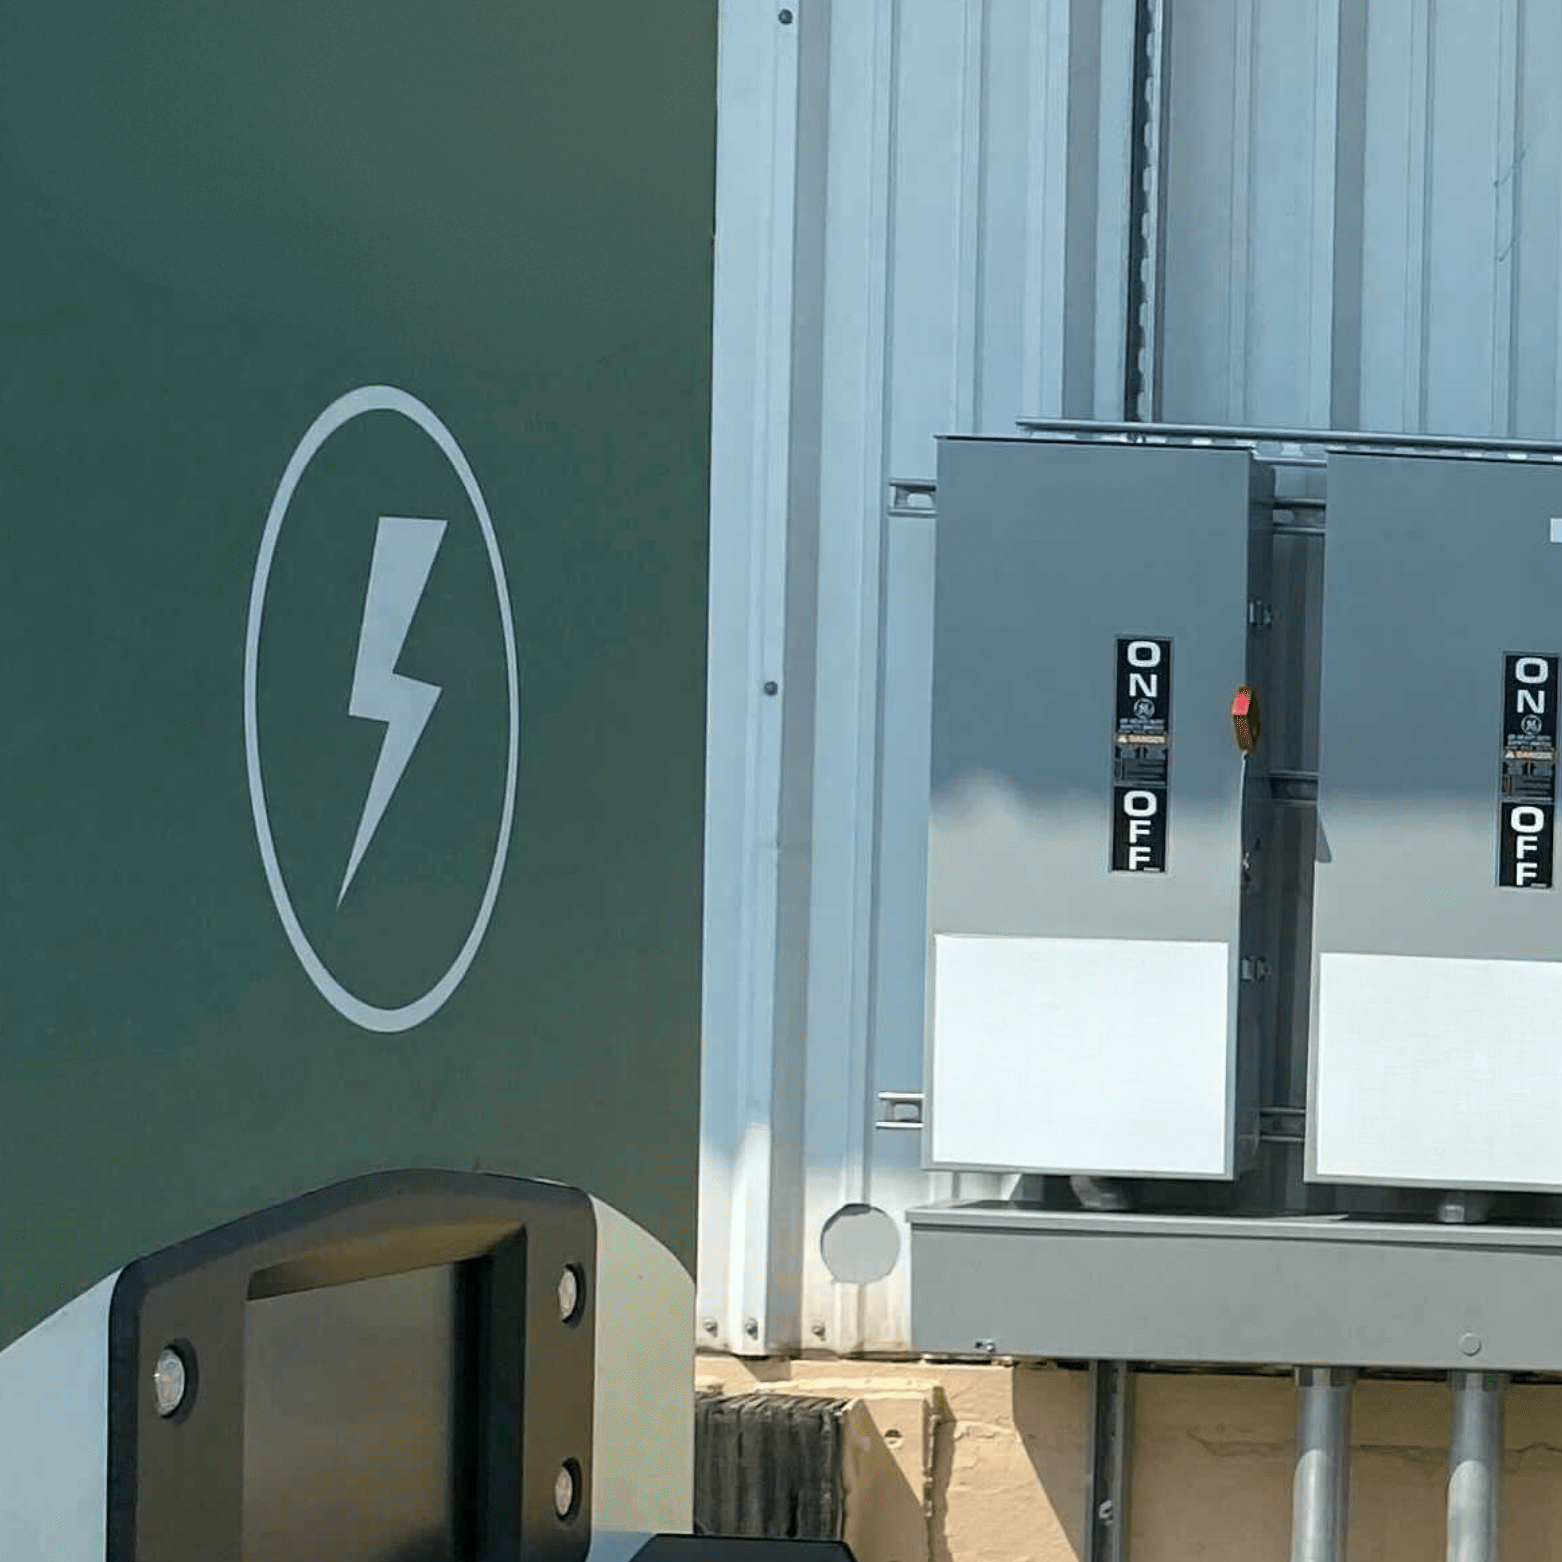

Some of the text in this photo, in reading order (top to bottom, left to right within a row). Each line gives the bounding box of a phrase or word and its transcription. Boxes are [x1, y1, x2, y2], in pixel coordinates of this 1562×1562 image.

[1127, 640, 1161, 698] ON
[1515, 656, 1549, 714] ON
[1123, 790, 1158, 870] OFF
[1510, 806, 1545, 886] OFF
